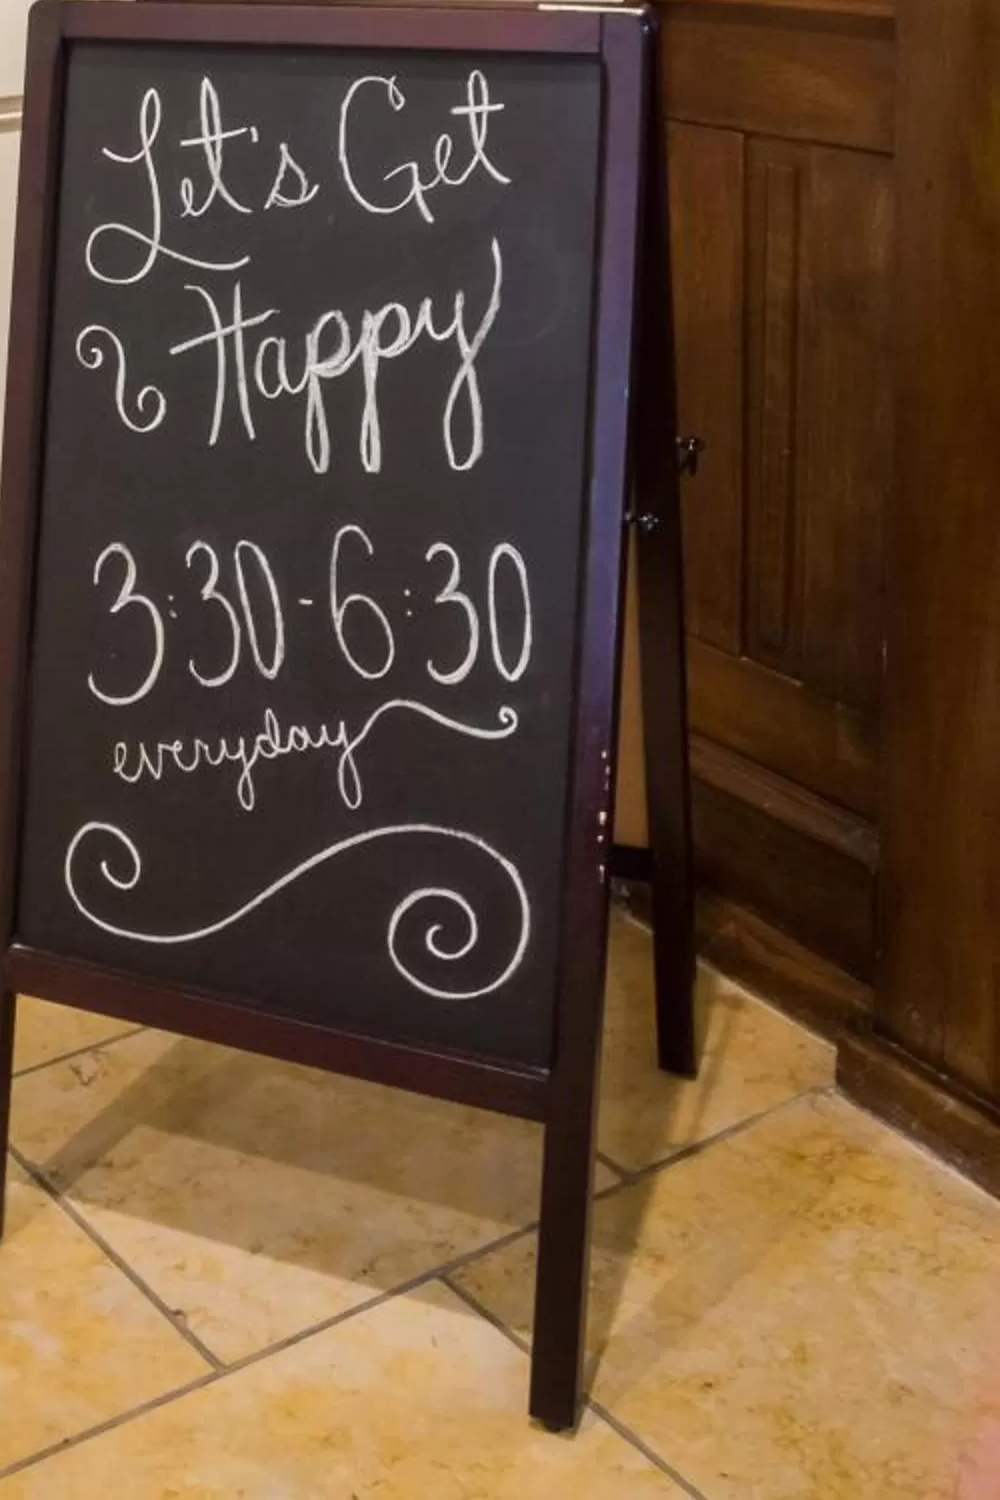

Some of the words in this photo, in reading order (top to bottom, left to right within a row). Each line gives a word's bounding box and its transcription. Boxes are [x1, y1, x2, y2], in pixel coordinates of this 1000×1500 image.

[86, 76, 319, 284] Let's
[339, 70, 512, 223] Get
[170, 237, 503, 474] Happy
[113, 707, 378, 812] everyday
